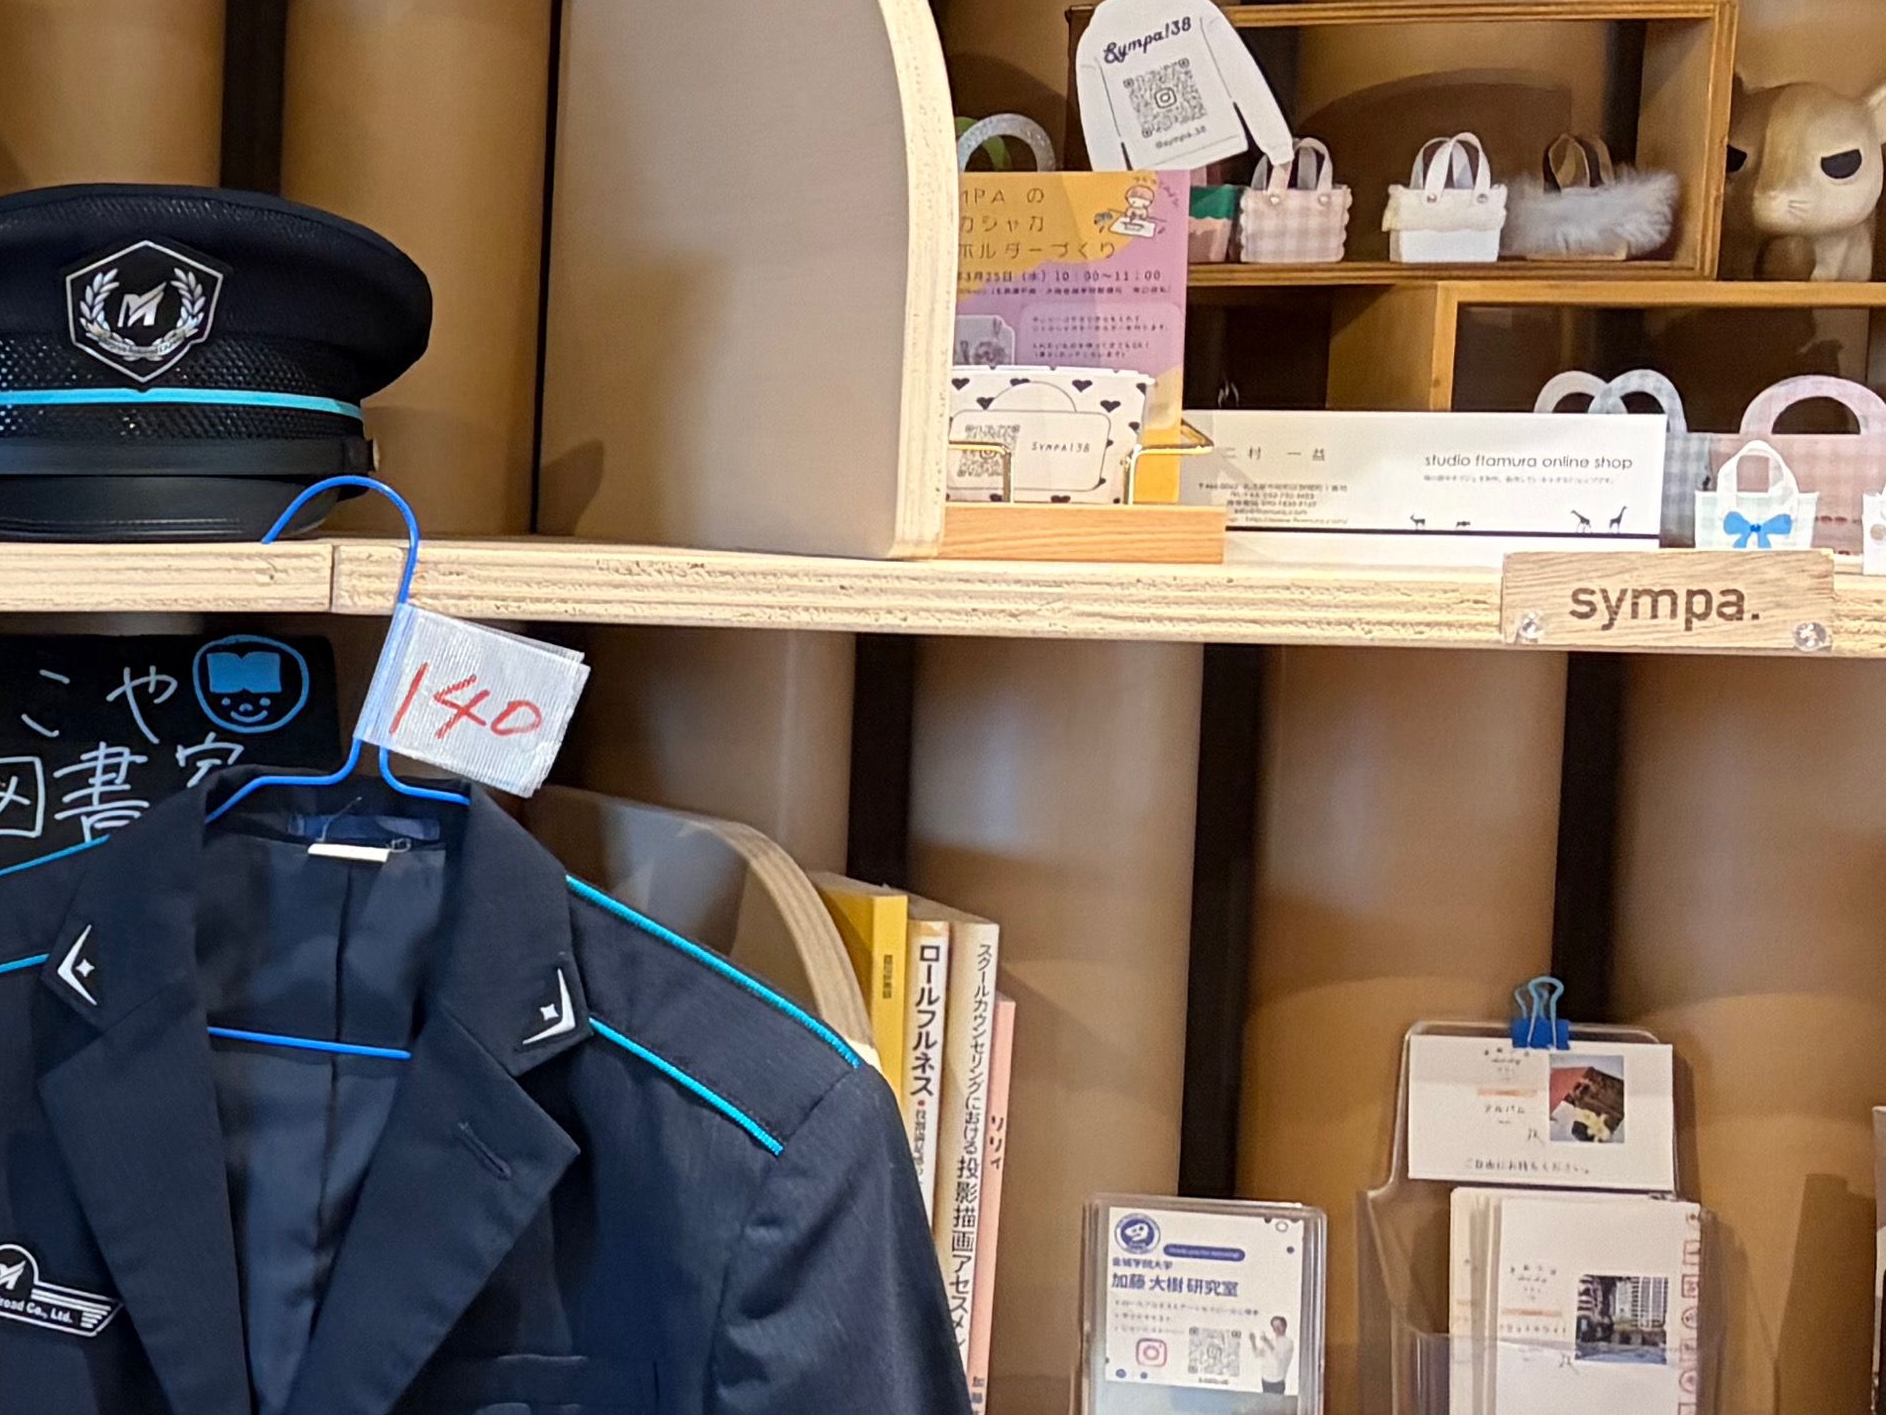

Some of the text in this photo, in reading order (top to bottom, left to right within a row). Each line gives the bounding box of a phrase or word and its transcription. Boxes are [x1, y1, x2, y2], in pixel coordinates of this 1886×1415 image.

[1026, 187, 1045, 205] の
[1424, 453, 1634, 472] studio online shop
[1567, 579, 1761, 632] sympa.
[386, 661, 544, 741] 140
[909, 944, 941, 1098] ロールフルネス
[1111, 1273, 1240, 1298] 加藤 大樹 研究室
